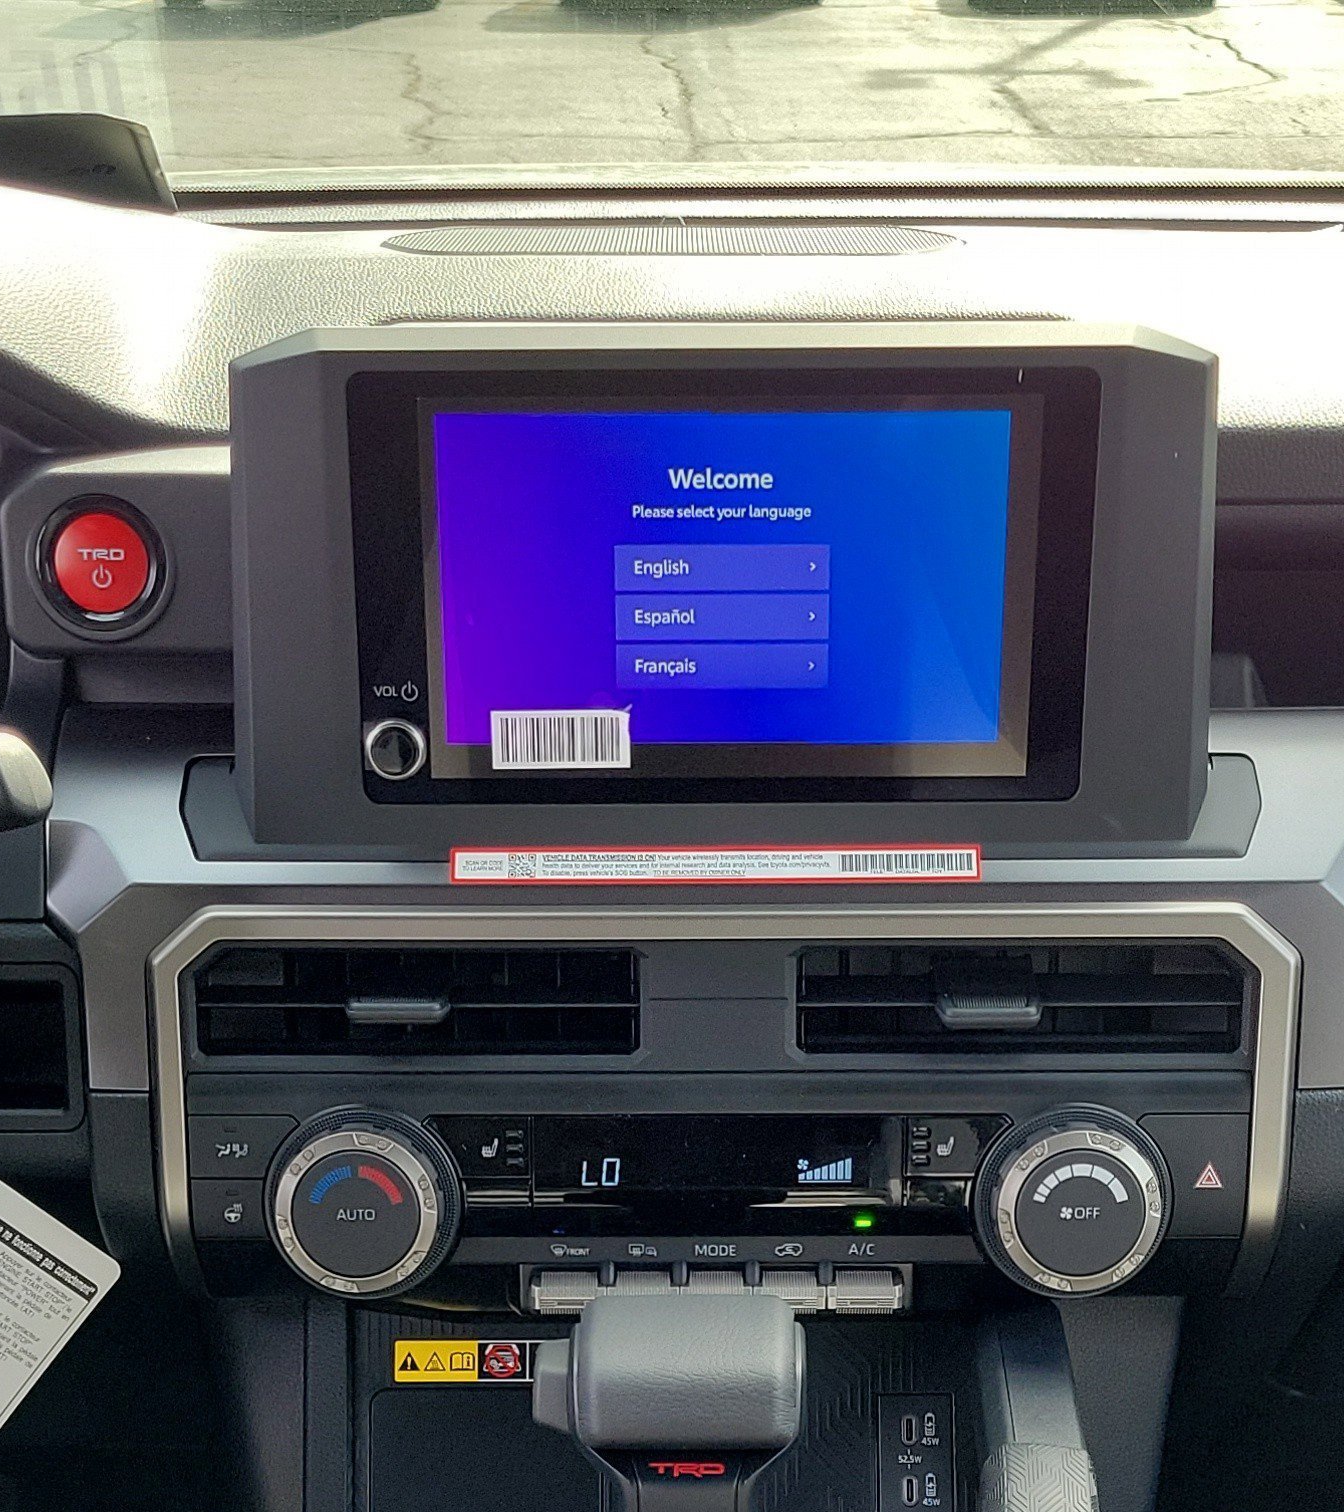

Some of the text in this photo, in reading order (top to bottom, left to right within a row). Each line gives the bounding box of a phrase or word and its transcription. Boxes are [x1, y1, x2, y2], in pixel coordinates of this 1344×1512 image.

[668, 467, 774, 490] Welcome
[632, 504, 812, 521] Please select your language
[77, 548, 125, 561] TRD
[634, 559, 690, 579] English
[634, 608, 695, 628] Español
[634, 657, 696, 677] Français
[373, 685, 399, 697] VOL
[336, 1207, 376, 1223] AUTO
[1074, 1207, 1101, 1220] OFF
[566, 1246, 591, 1257] FRONT
[694, 1243, 737, 1257] MODE
[848, 1243, 876, 1257] A/C
[921, 1437, 940, 1446] 45W
[898, 1455, 922, 1464] 52.5W
[648, 1462, 726, 1478] TRD
[922, 1497, 941, 1507] 45W
